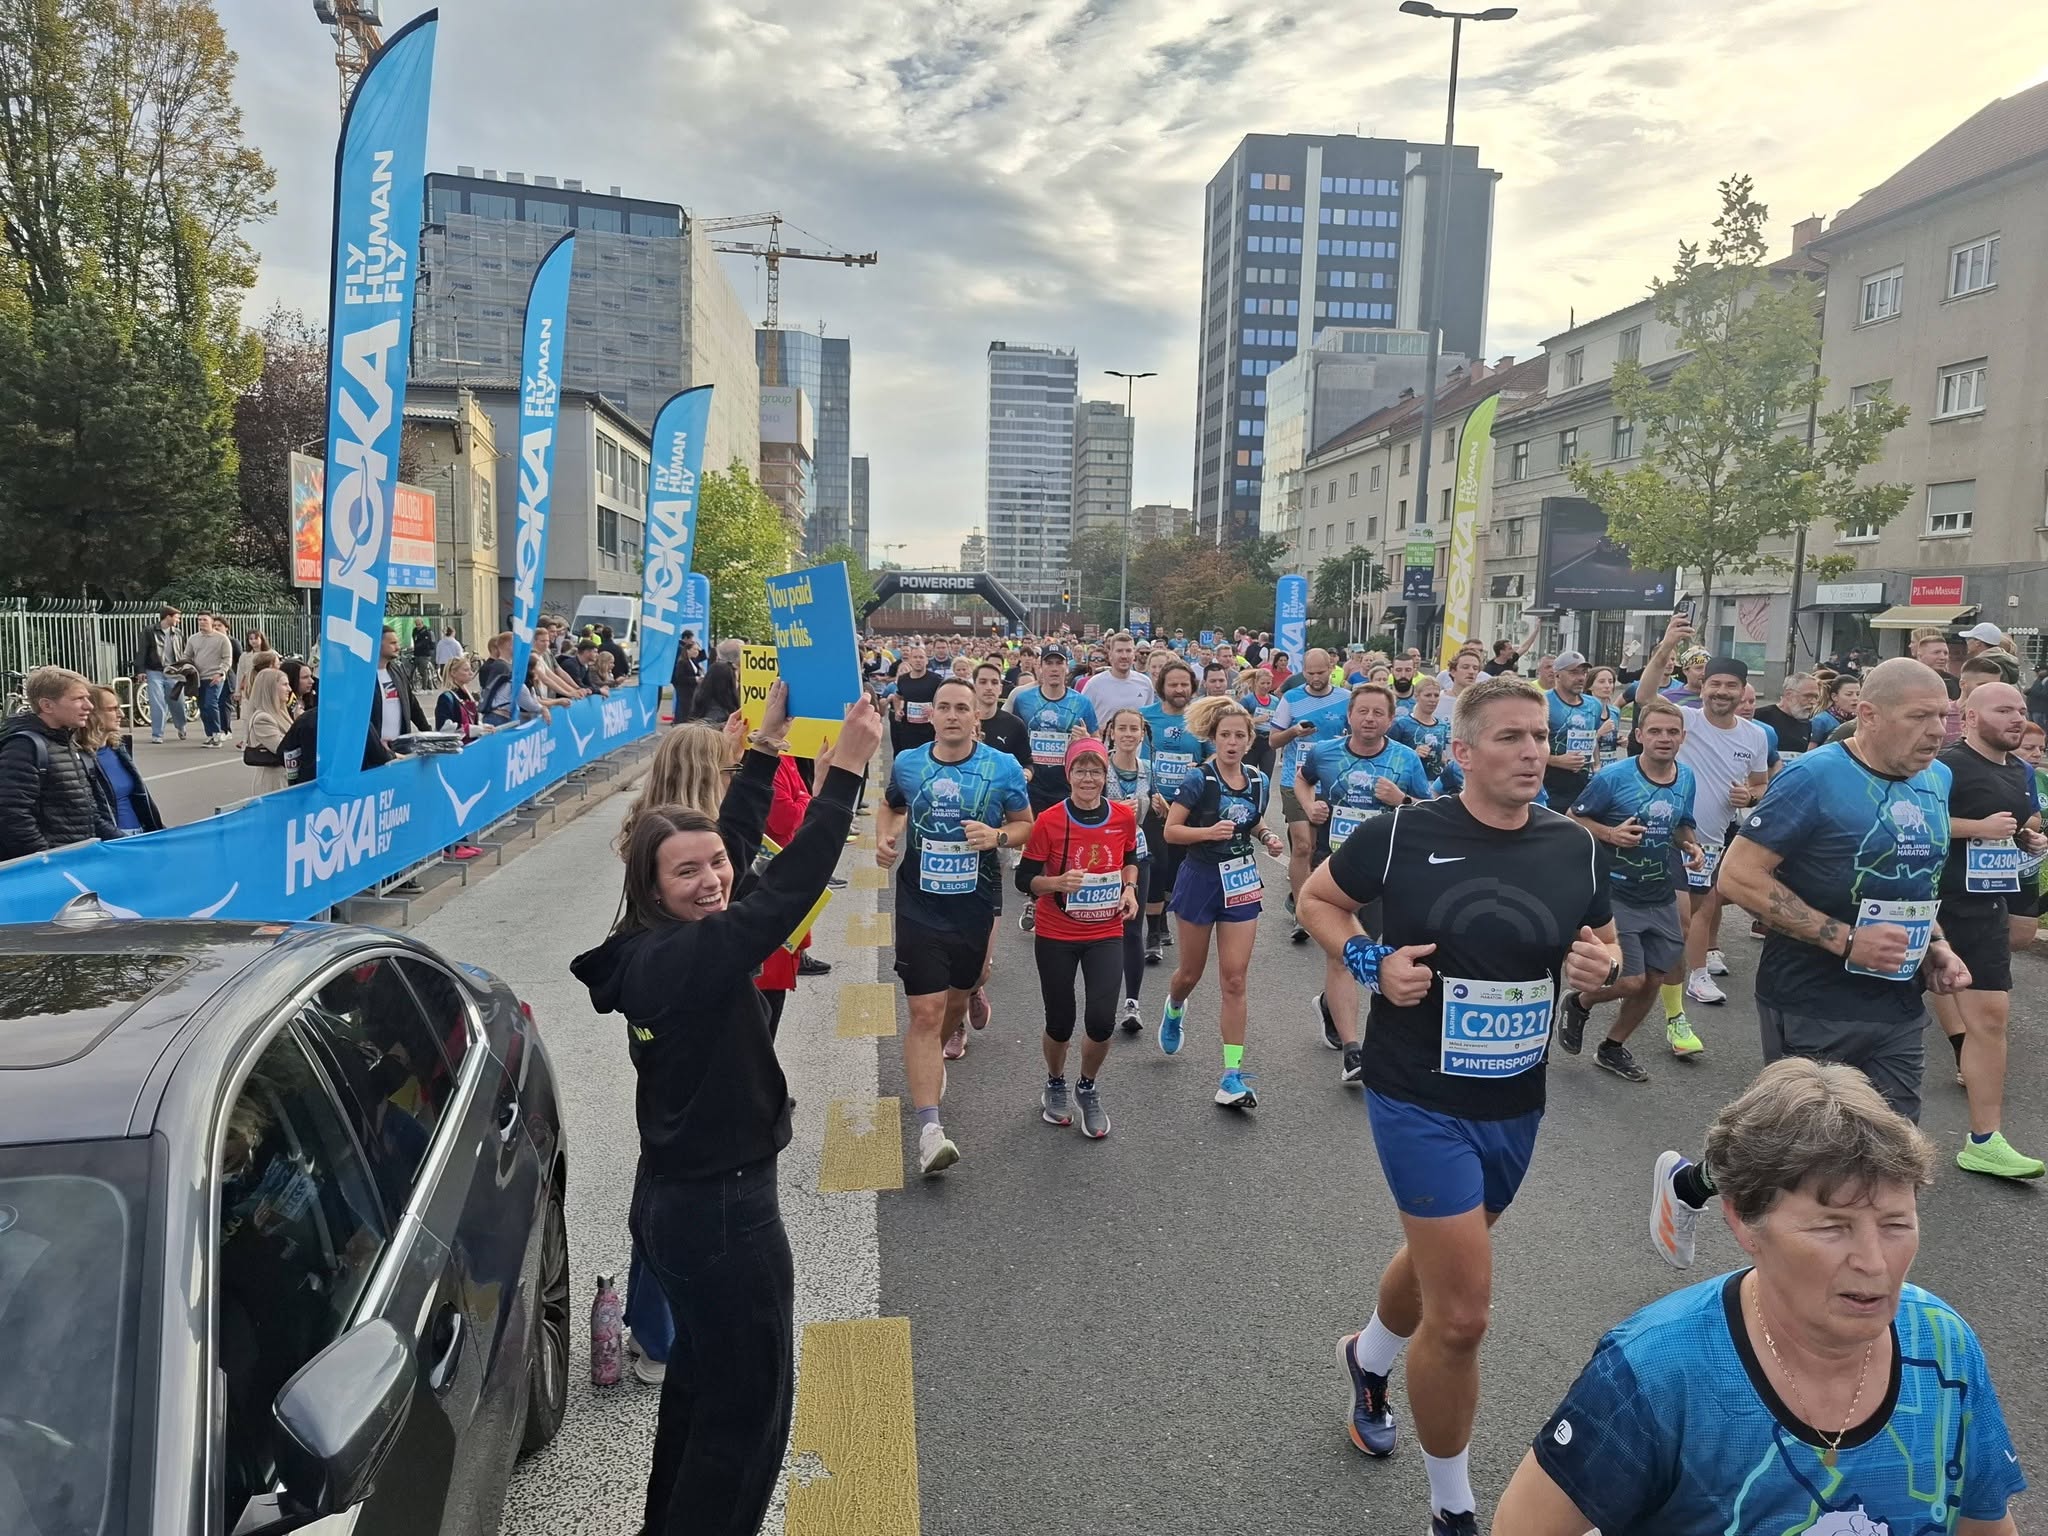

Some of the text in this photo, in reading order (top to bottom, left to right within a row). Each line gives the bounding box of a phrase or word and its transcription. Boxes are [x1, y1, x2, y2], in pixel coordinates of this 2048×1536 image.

[365, 150, 394, 304] HUMAN
[344, 242, 366, 304] FLY
[383, 239, 407, 303] FLY
[535, 318, 553, 417] HUMAN
[524, 376, 537, 417] FLY
[545, 376, 557, 417] FLY
[655, 465, 670, 491] FLY
[668, 431, 688, 493] HUMAN
[327, 319, 400, 663] HOKA
[680, 468, 696, 495] FLY
[512, 428, 552, 644] HOKA
[642, 500, 692, 636] HOKA
[899, 576, 975, 589] POWERADE
[1446, 510, 1476, 643] HOKA
[768, 575, 814, 614] You paid
[1290, 581, 1300, 618] HUMAN
[774, 618, 813, 649] for this.
[743, 685, 766, 704] you
[505, 731, 542, 792] HOKA
[1035, 742, 1065, 751] C18654
[380, 788, 395, 811] FLY
[378, 803, 411, 833] HUMAN
[286, 794, 377, 897] HOKA
[378, 830, 393, 855] FLY
[1896, 849, 1930, 857] MARATON
[928, 856, 977, 872] C22143
[1978, 853, 2017, 869] C24304
[1076, 886, 1120, 902] C18260
[1461, 1008, 1547, 1038] C20321
[1465, 1051, 1539, 1070] INTERSPORT
